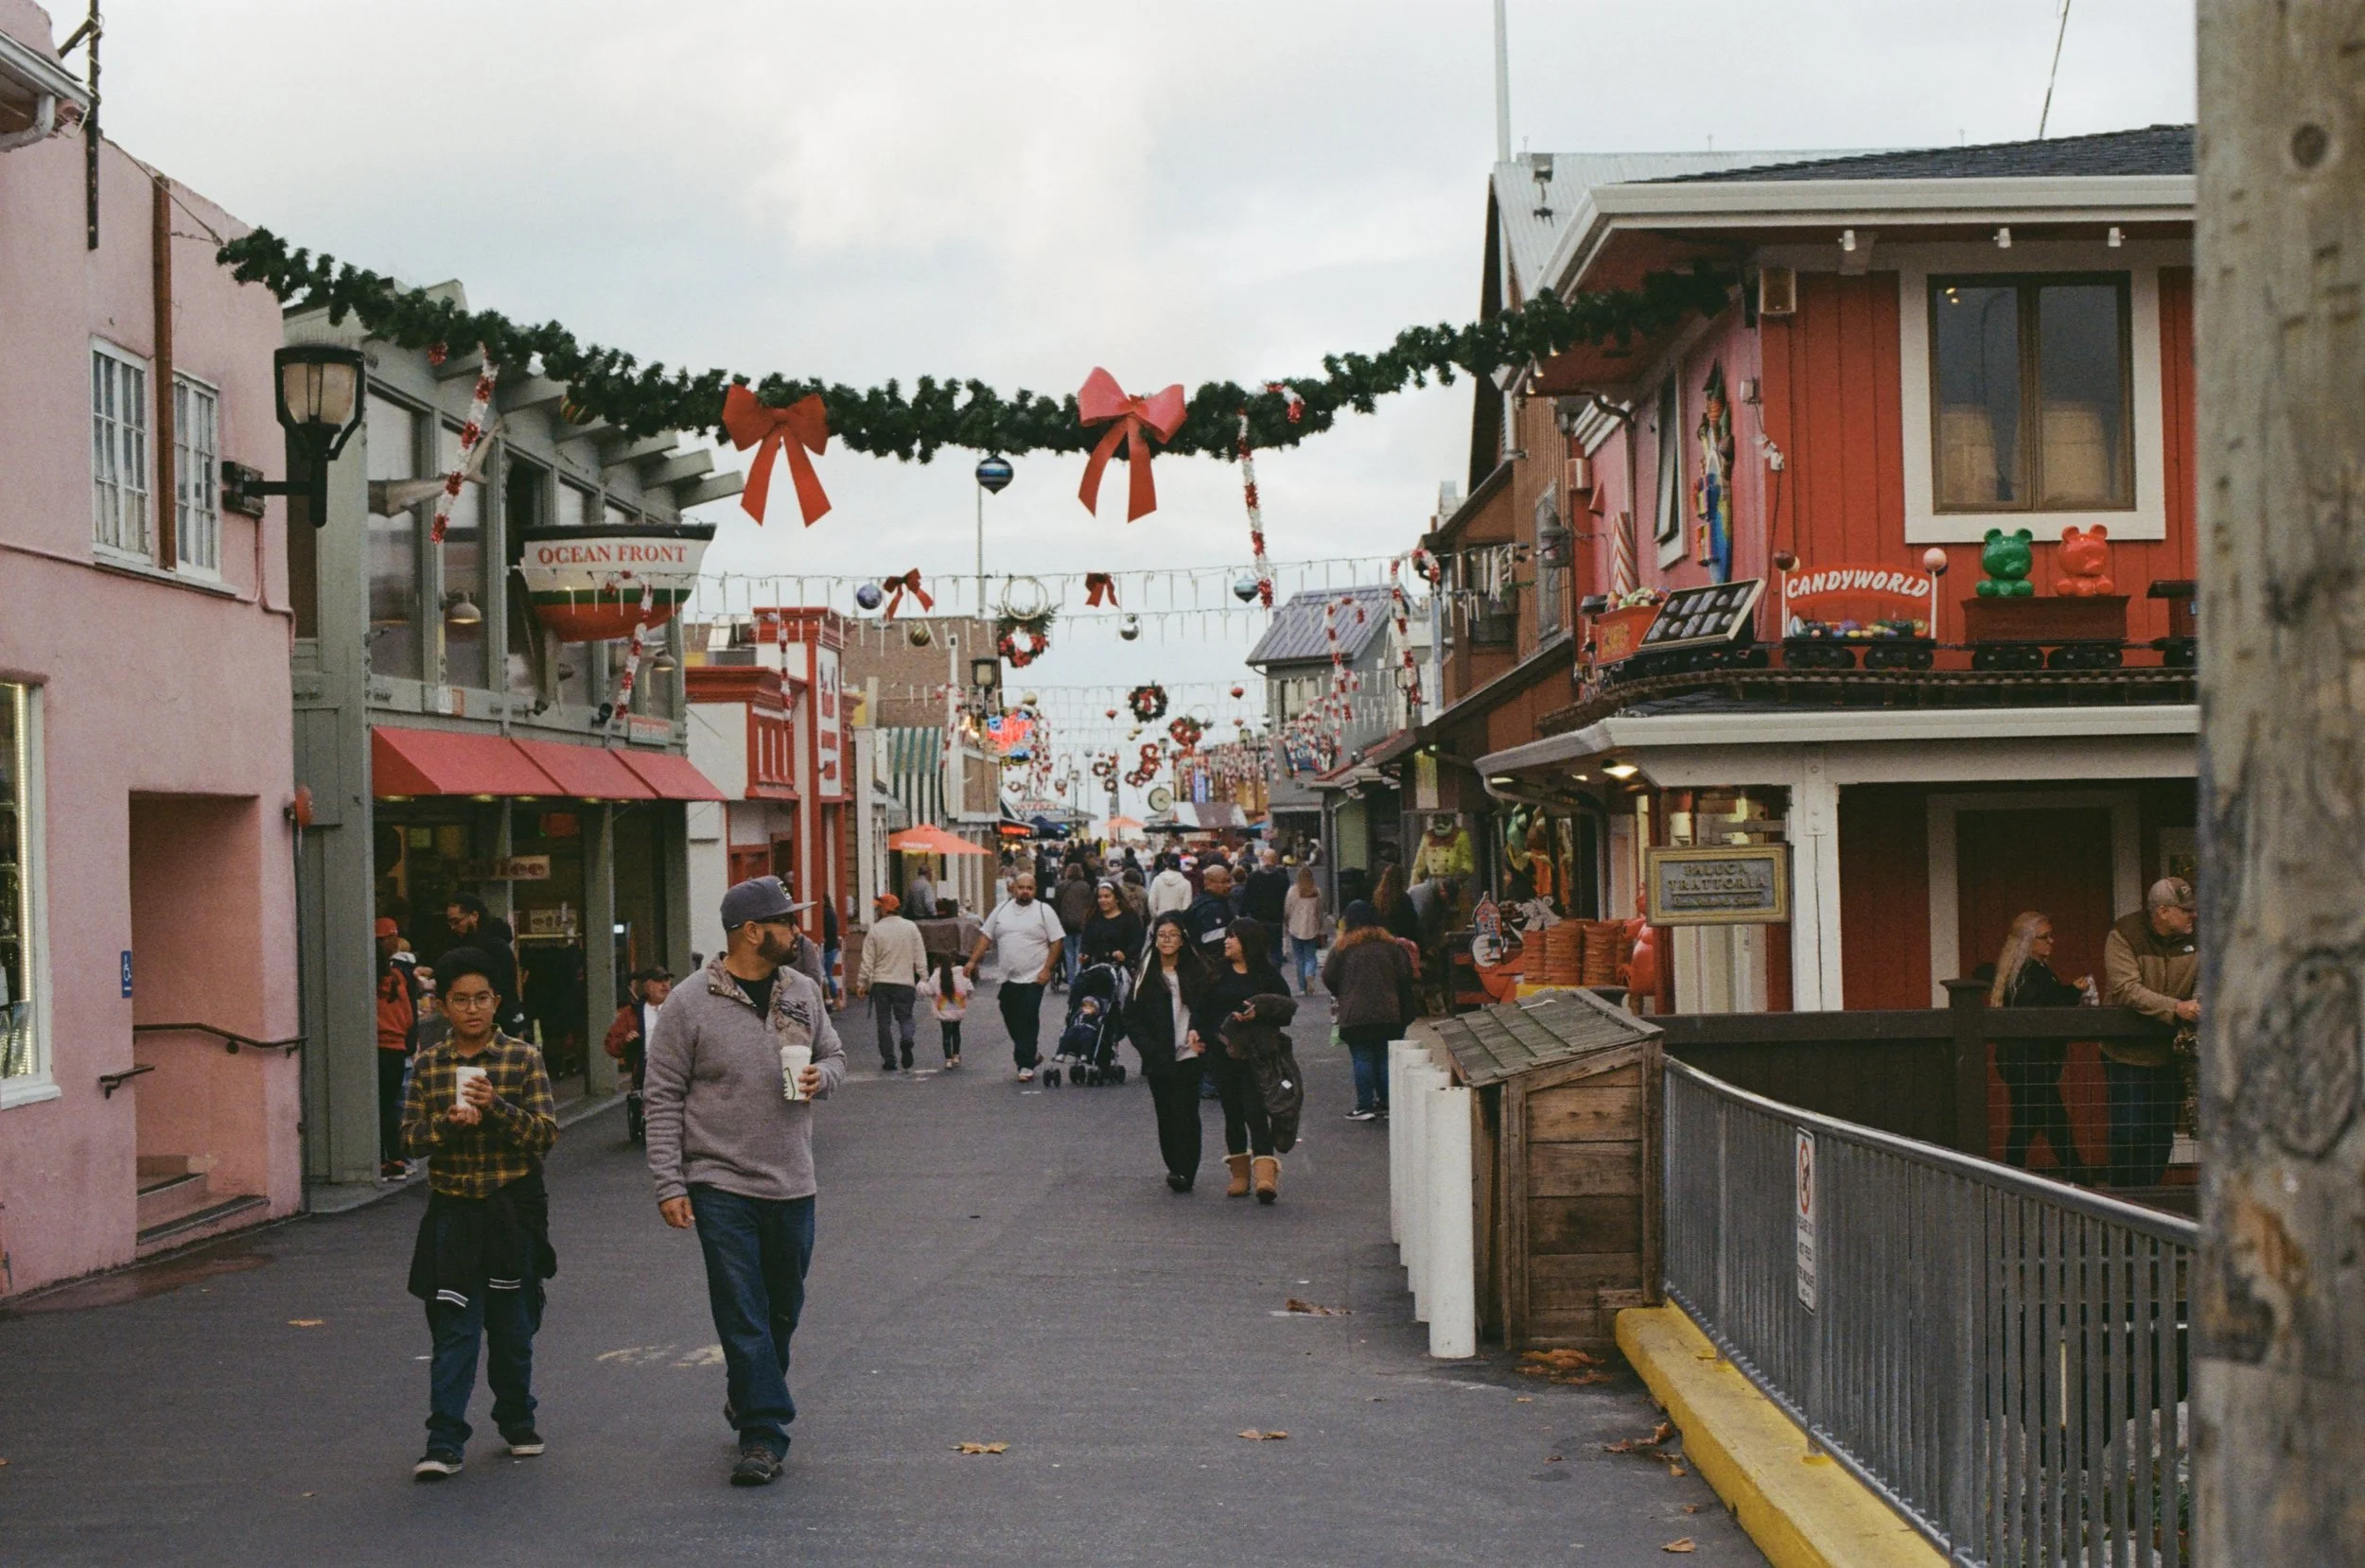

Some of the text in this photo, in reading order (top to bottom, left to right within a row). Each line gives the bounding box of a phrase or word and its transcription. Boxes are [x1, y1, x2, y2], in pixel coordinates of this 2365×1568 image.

[537, 543, 687, 565] OCEAN FRONT
[1786, 569, 1930, 598] CANDYWORLD
[1668, 877, 1769, 890] TRATTORIA
